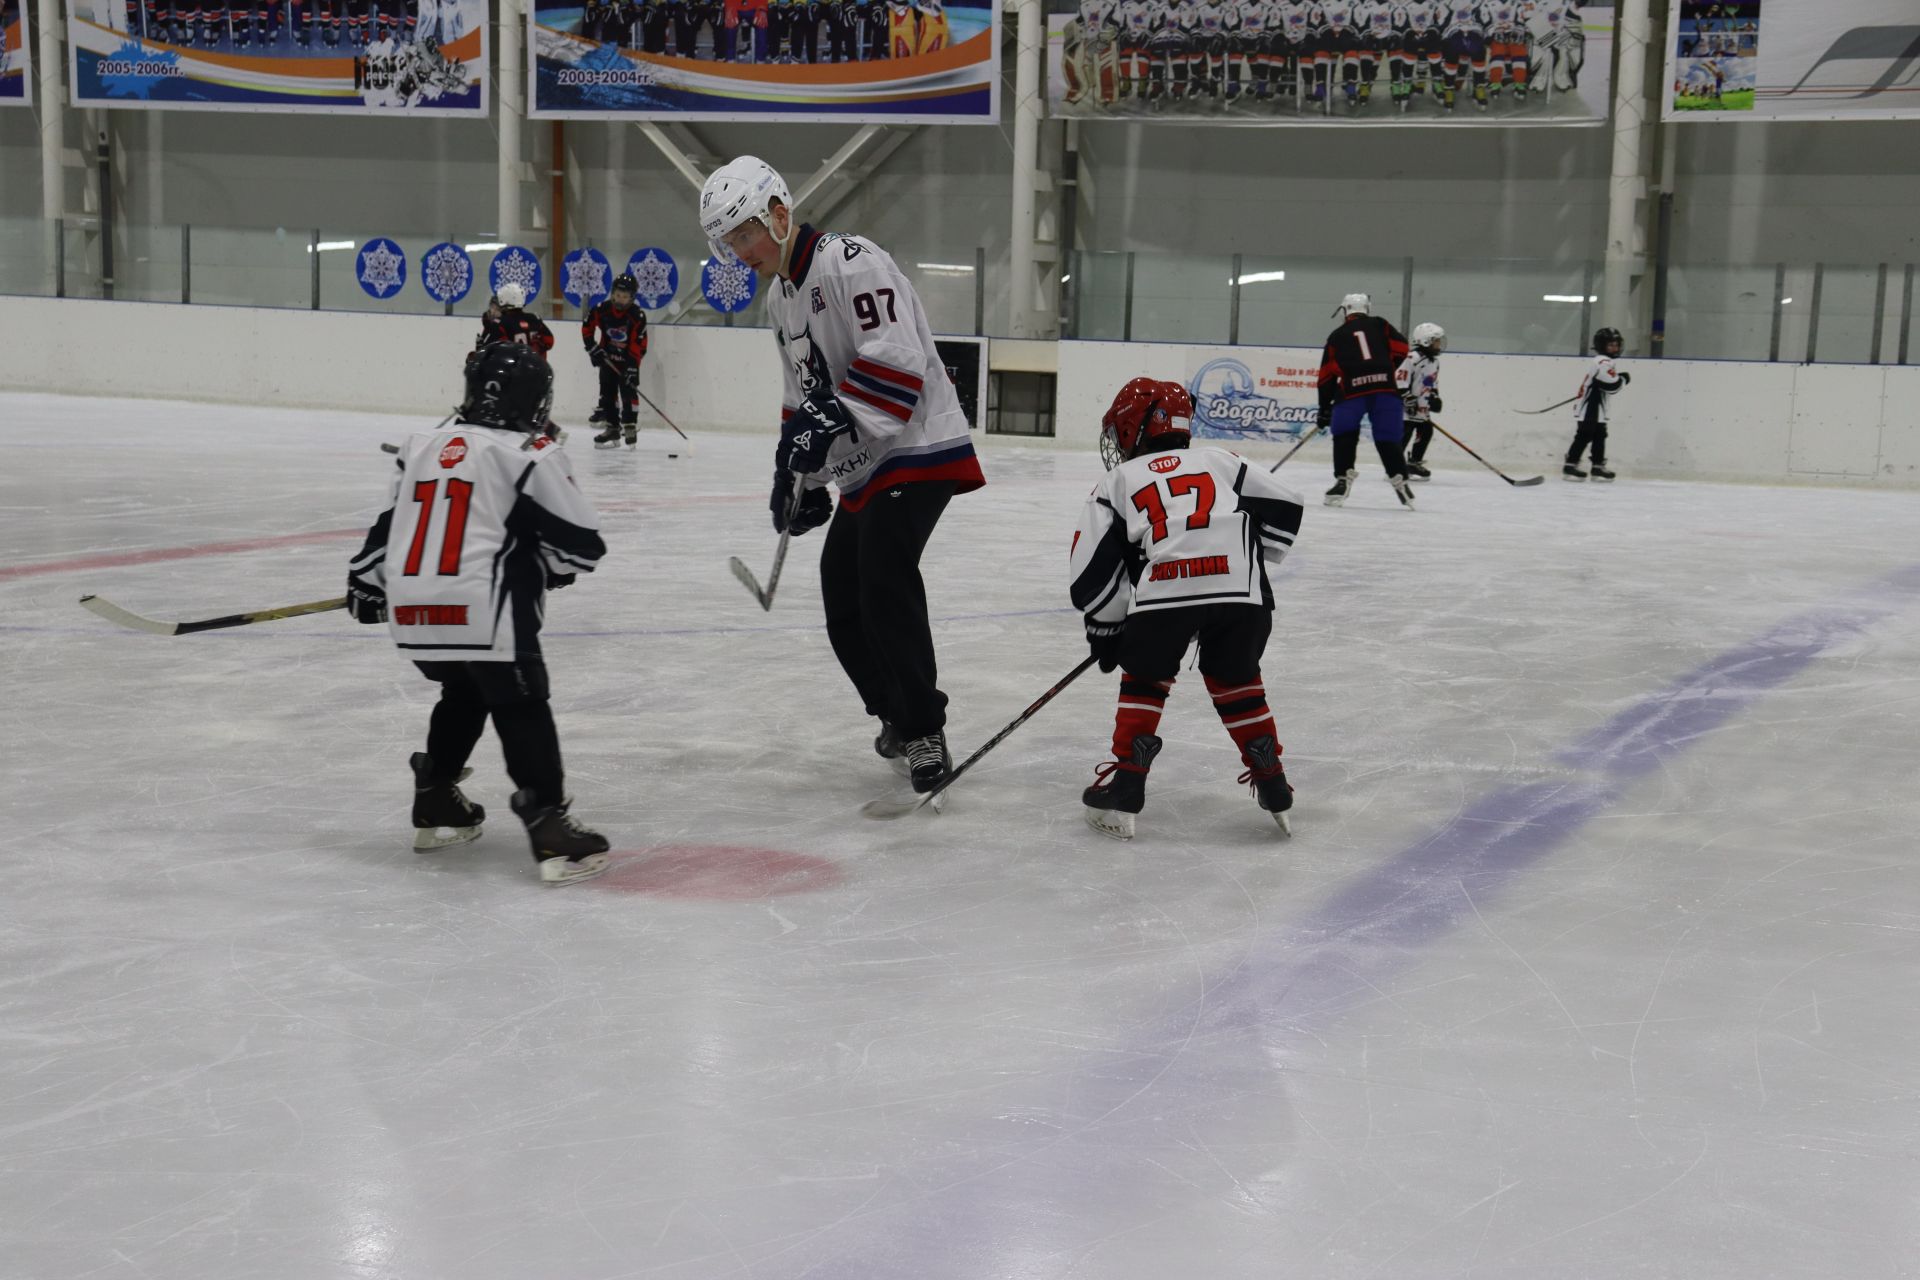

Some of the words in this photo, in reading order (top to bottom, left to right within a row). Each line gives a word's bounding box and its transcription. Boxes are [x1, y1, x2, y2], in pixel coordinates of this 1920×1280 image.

[97, 61, 185, 76] 2005-2006гг.
[558, 69, 656, 85] 2003-2004гг.
[852, 287, 898, 332] 97
[1353, 330, 1372, 360] 1
[1208, 397, 1320, 428] Водокана
[1150, 457, 1179, 471] STOP
[1131, 471, 1217, 545] 17
[403, 477, 475, 577] 11
